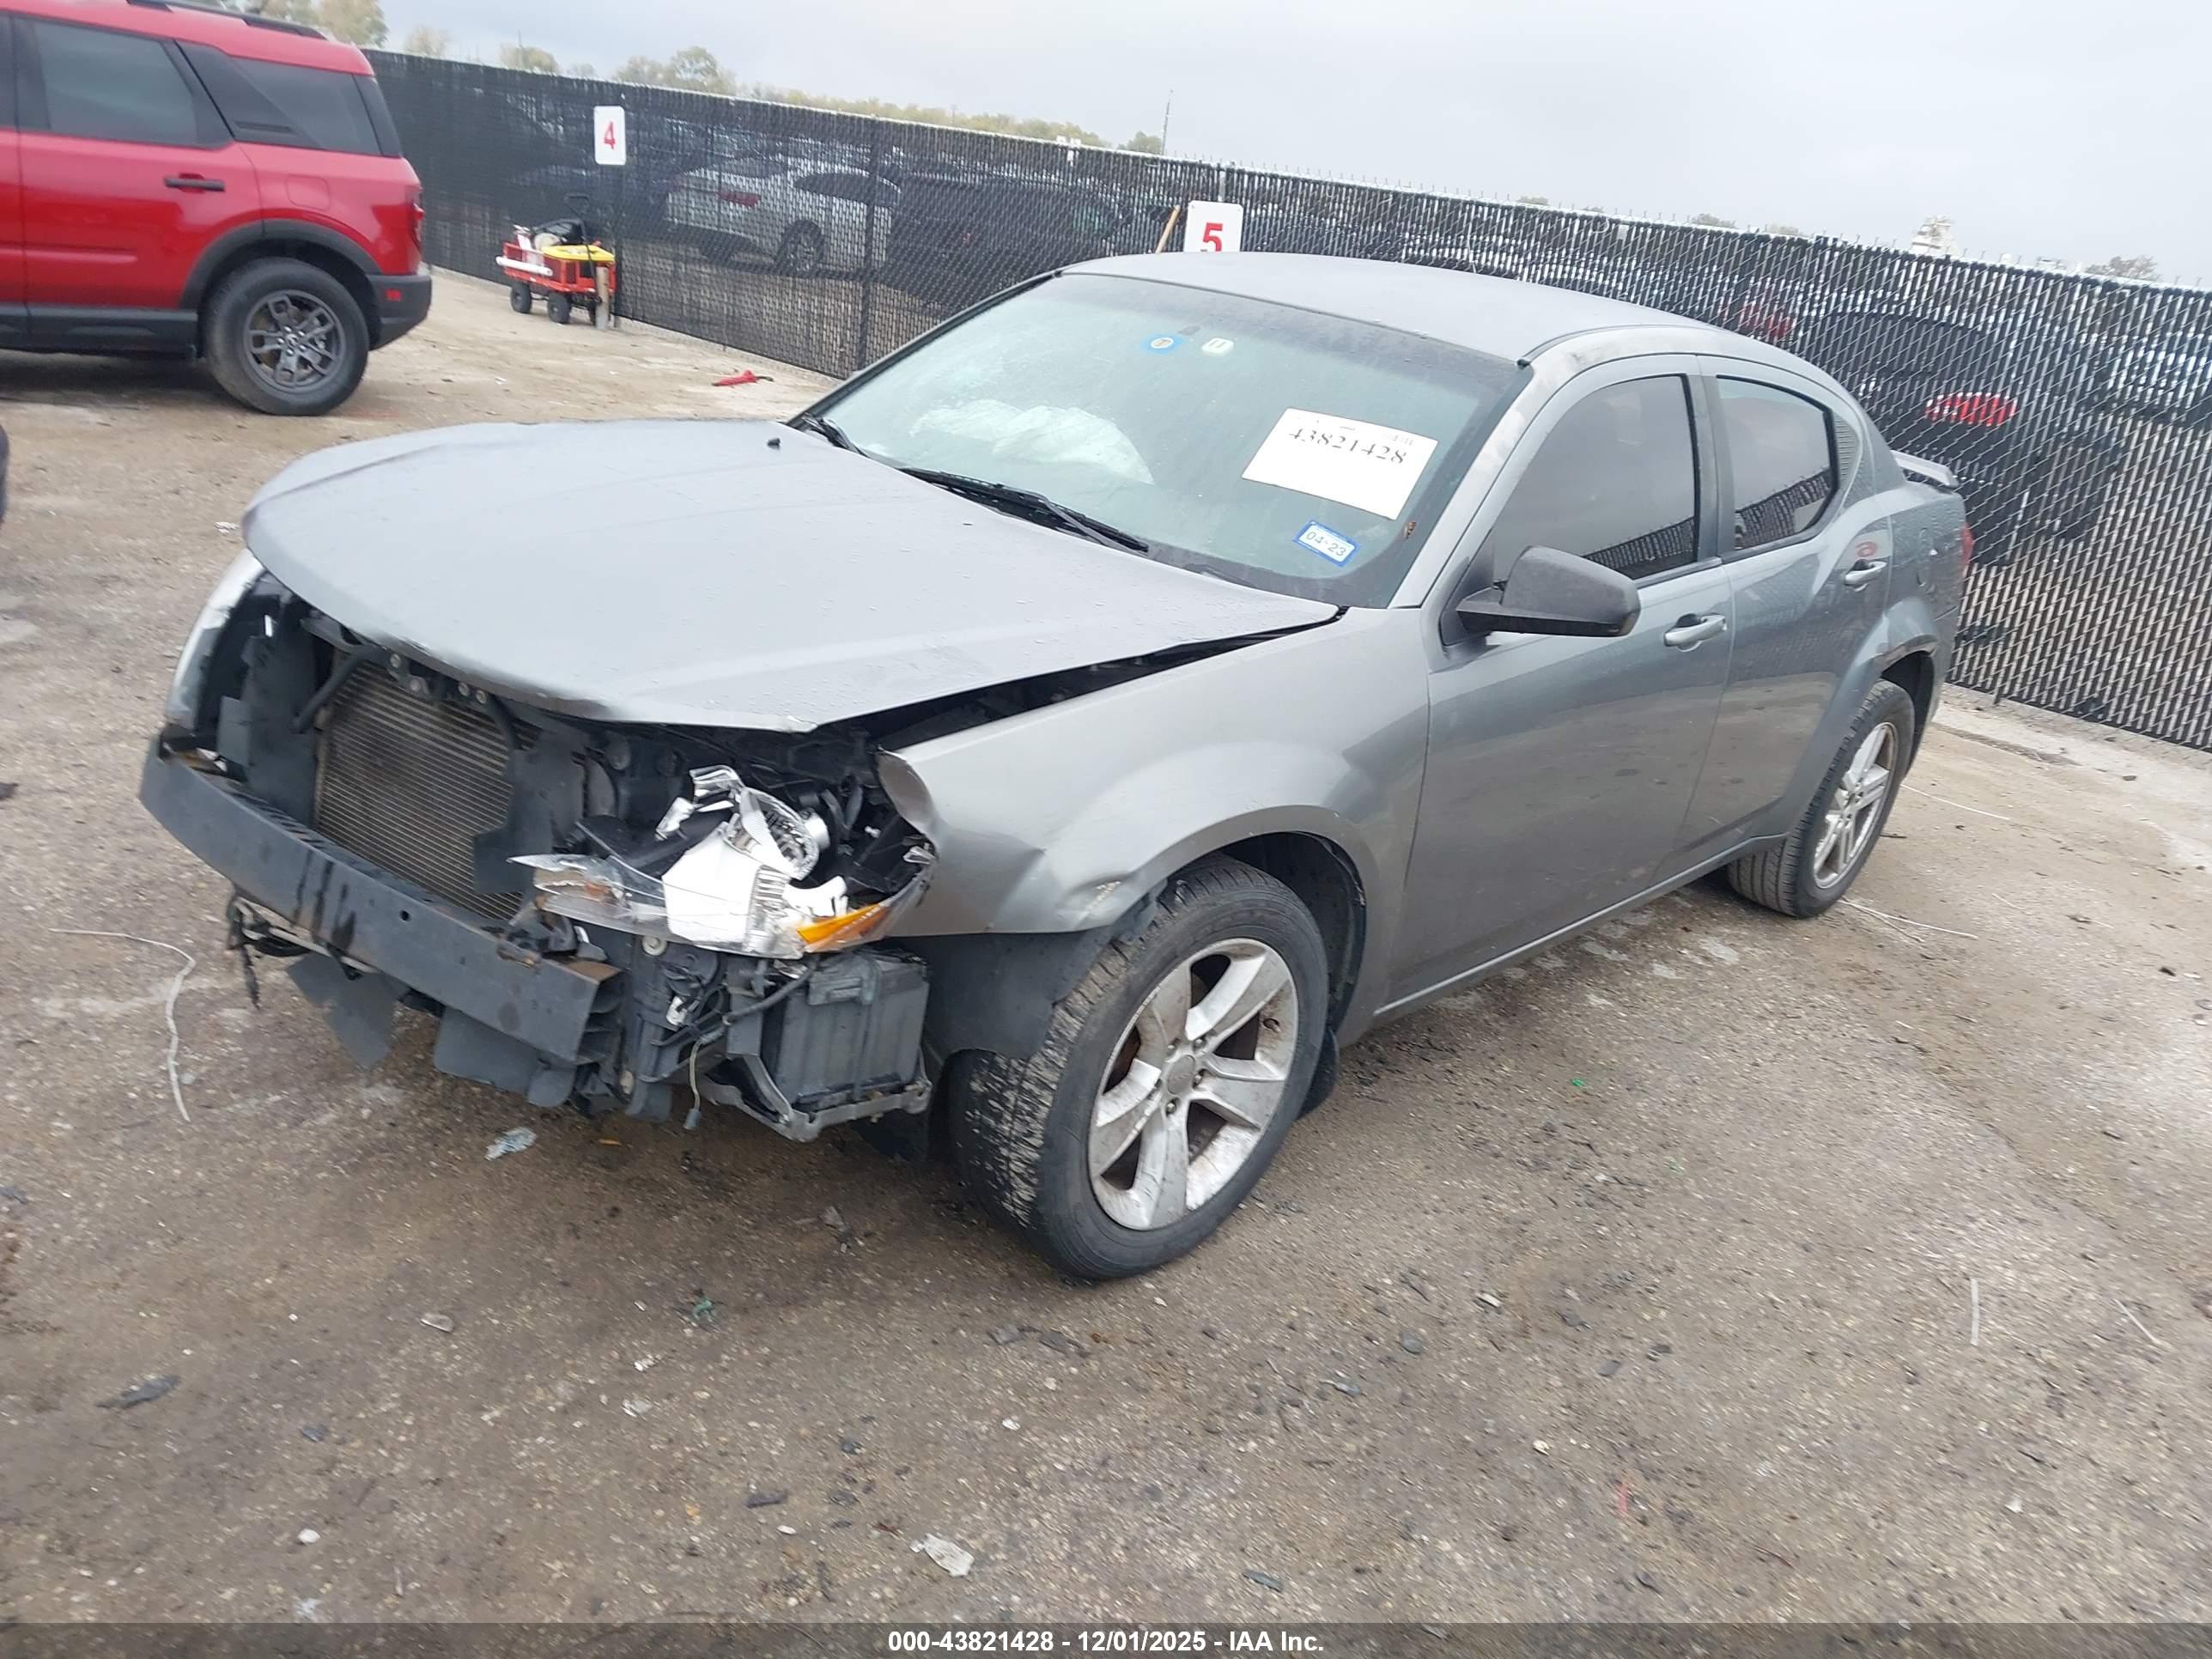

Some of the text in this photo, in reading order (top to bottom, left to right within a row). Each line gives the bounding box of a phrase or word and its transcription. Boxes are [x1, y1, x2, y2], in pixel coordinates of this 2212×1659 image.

[604, 121, 616, 149] 4
[1201, 222, 1224, 252] 5
[1288, 428, 1407, 465] 43821428
